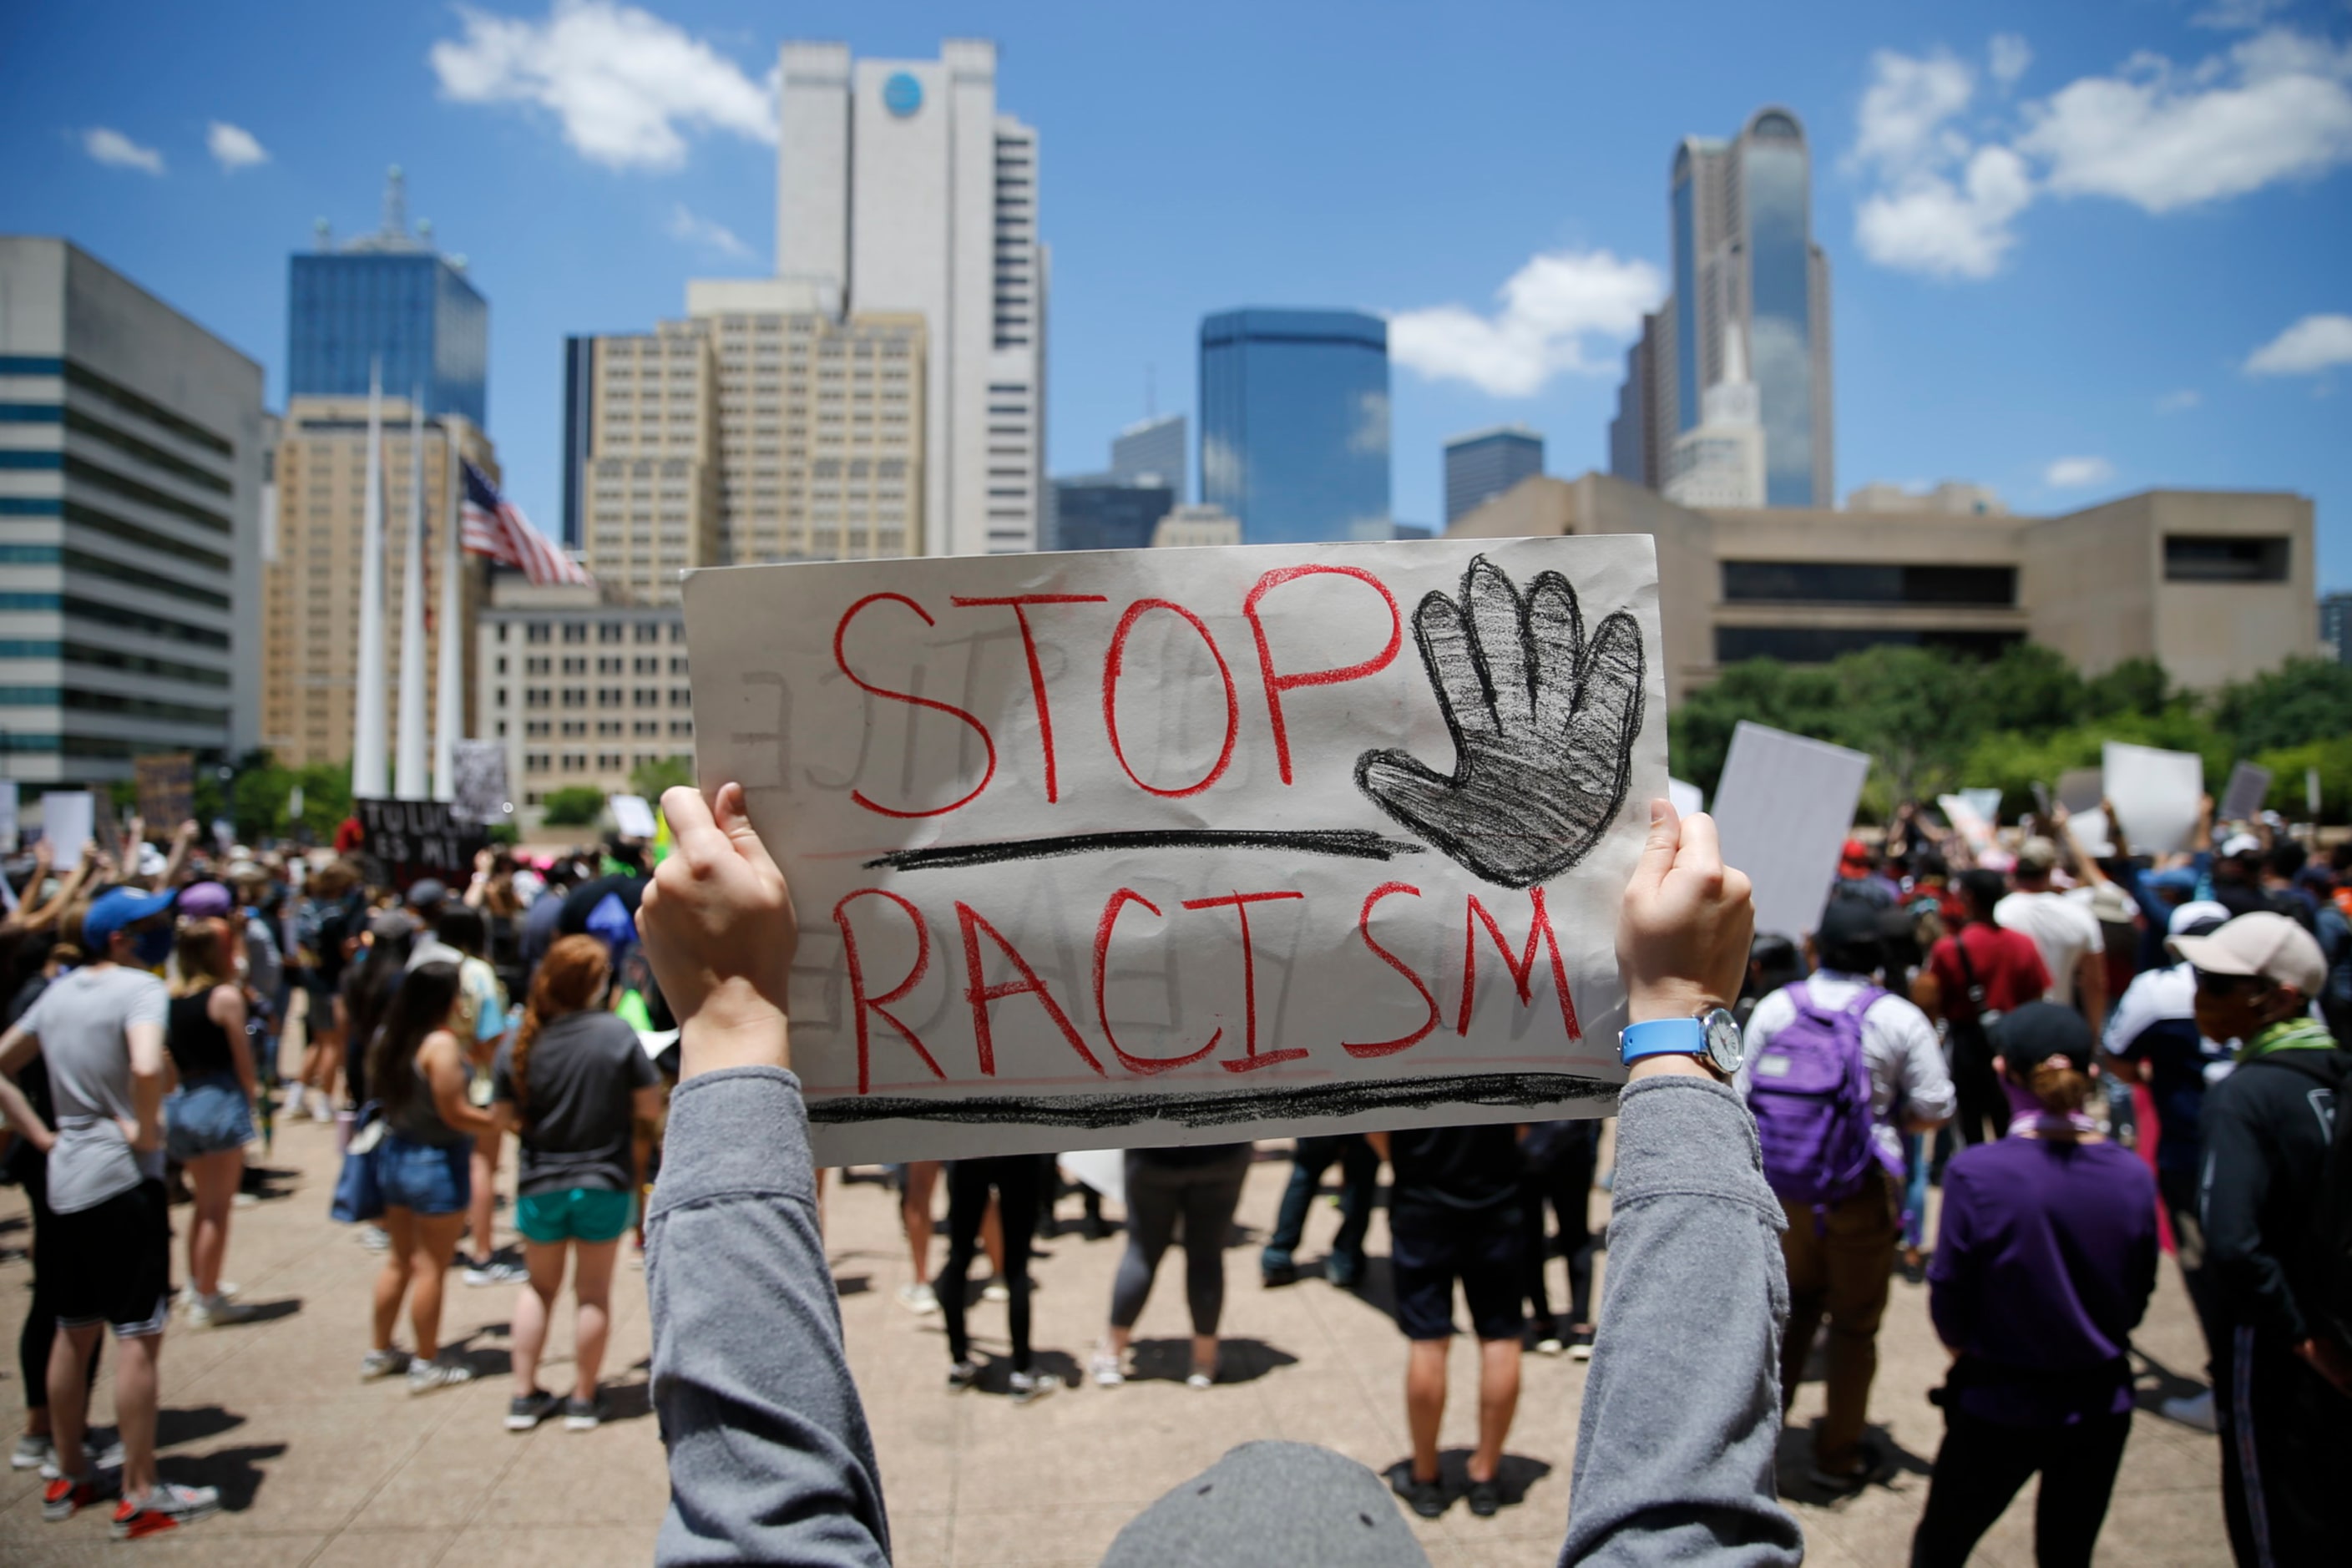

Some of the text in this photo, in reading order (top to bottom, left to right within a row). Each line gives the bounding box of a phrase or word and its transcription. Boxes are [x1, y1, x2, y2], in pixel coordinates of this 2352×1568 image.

[834, 564, 1402, 818] STOP
[374, 832, 461, 869] ES MI
[834, 881, 1581, 1095] RACISM
